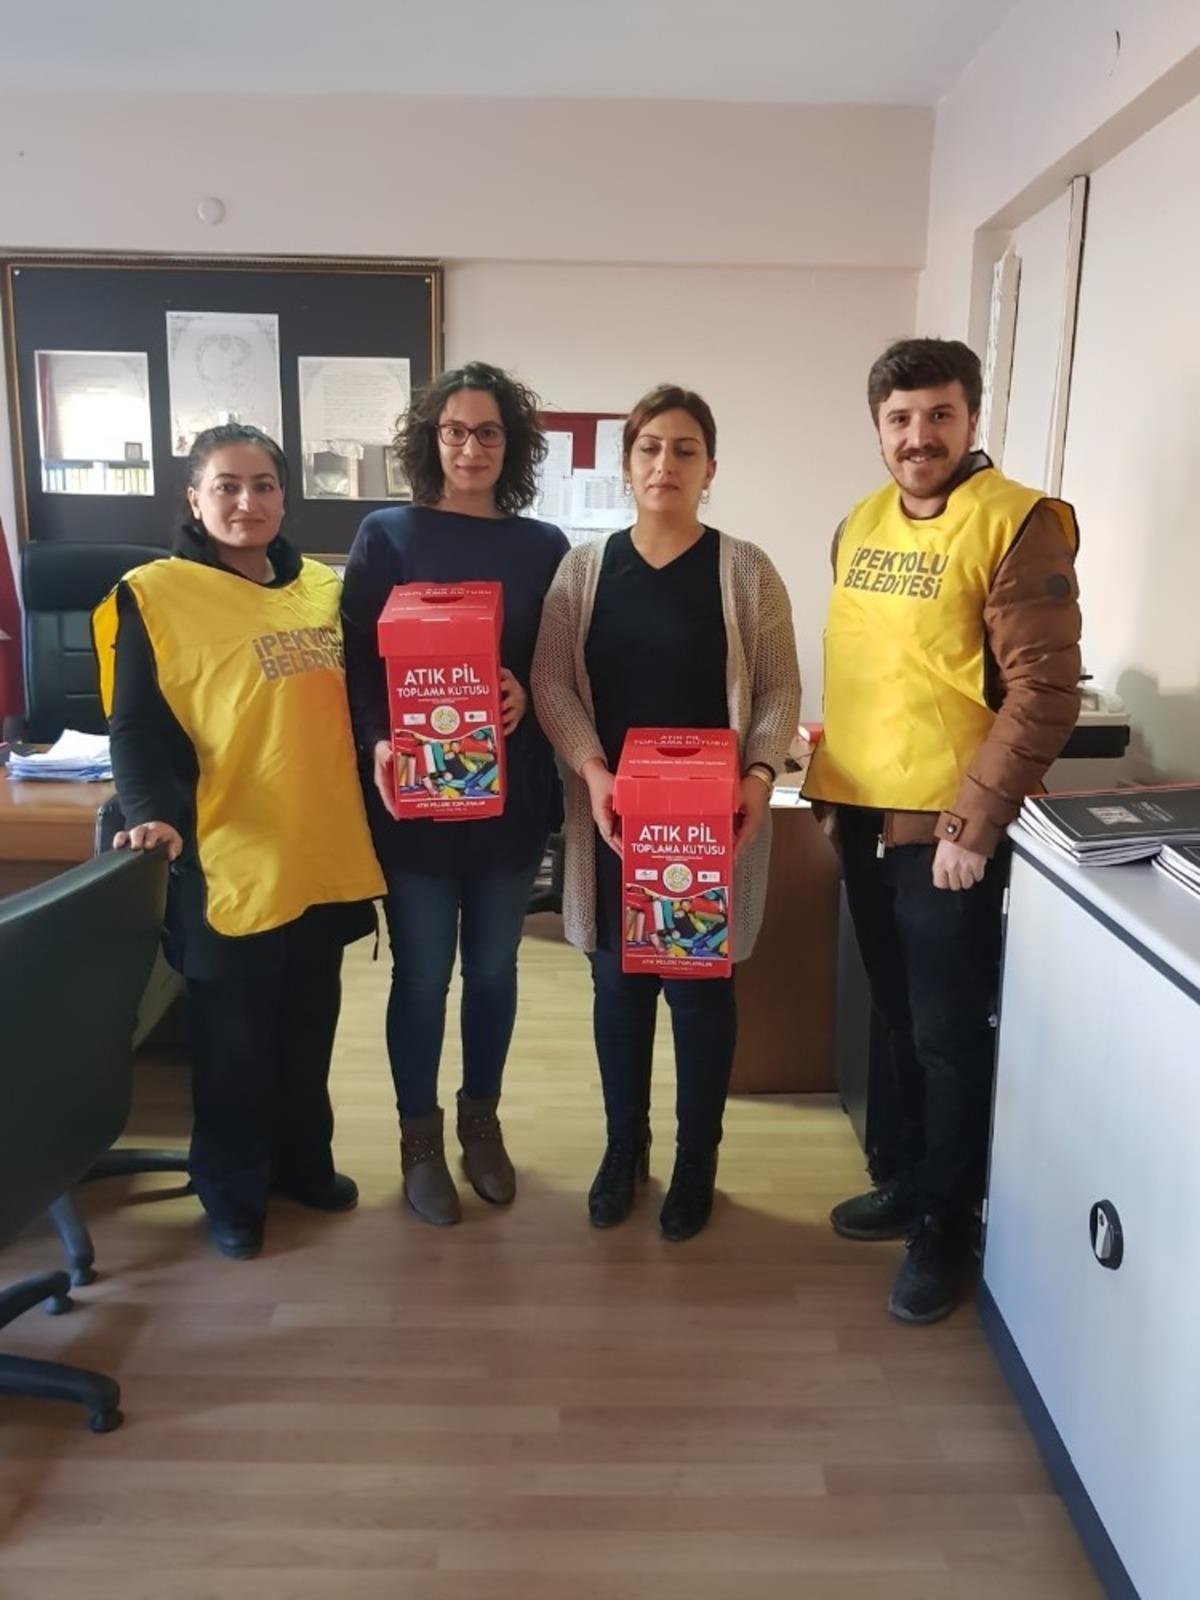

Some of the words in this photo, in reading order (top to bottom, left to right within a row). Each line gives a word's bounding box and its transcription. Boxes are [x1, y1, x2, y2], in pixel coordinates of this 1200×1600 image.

[850, 547, 949, 576] İPEKYOLU
[844, 568, 943, 600] BELEDİYESİ
[404, 668, 446, 686] ATIK
[452, 663, 480, 684] PİL
[396, 686, 446, 698] TOPLAMA
[448, 685, 490, 697] KUTUSU
[639, 825, 682, 843] ATIK
[688, 823, 717, 843] PİL
[631, 843, 680, 854] TOPLAMA
[682, 844, 726, 856] KUTUSU
